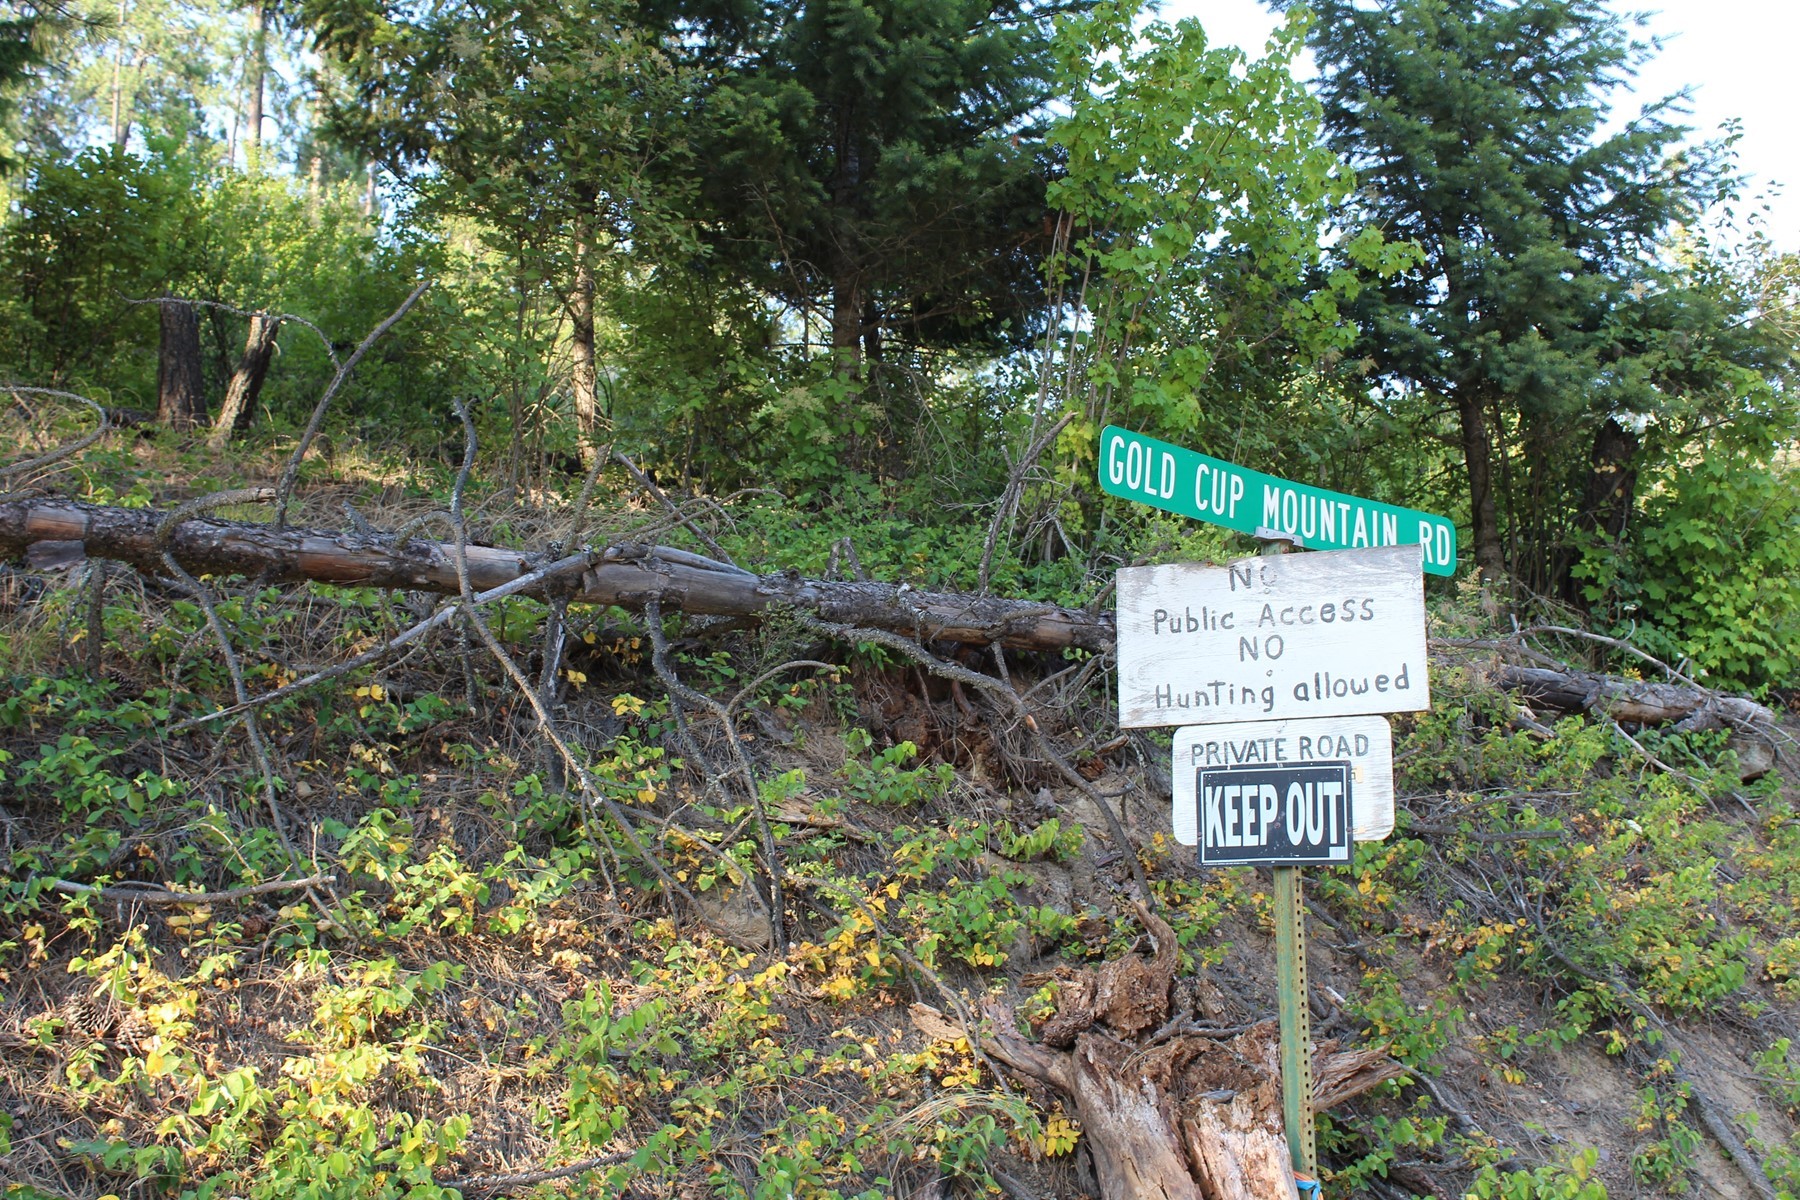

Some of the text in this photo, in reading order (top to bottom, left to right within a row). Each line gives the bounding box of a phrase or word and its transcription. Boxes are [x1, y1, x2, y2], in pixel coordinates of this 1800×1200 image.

[1109, 435, 1450, 566] GOLD CUP MOUNTAIN RD
[1228, 565, 1277, 592] NO
[1153, 598, 1374, 635] Public Access
[1239, 634, 1284, 662] NO
[1293, 662, 1410, 702] allowed
[1191, 733, 1369, 766] PRIVATE ROAD
[1205, 781, 1342, 848] KEEP OUT
